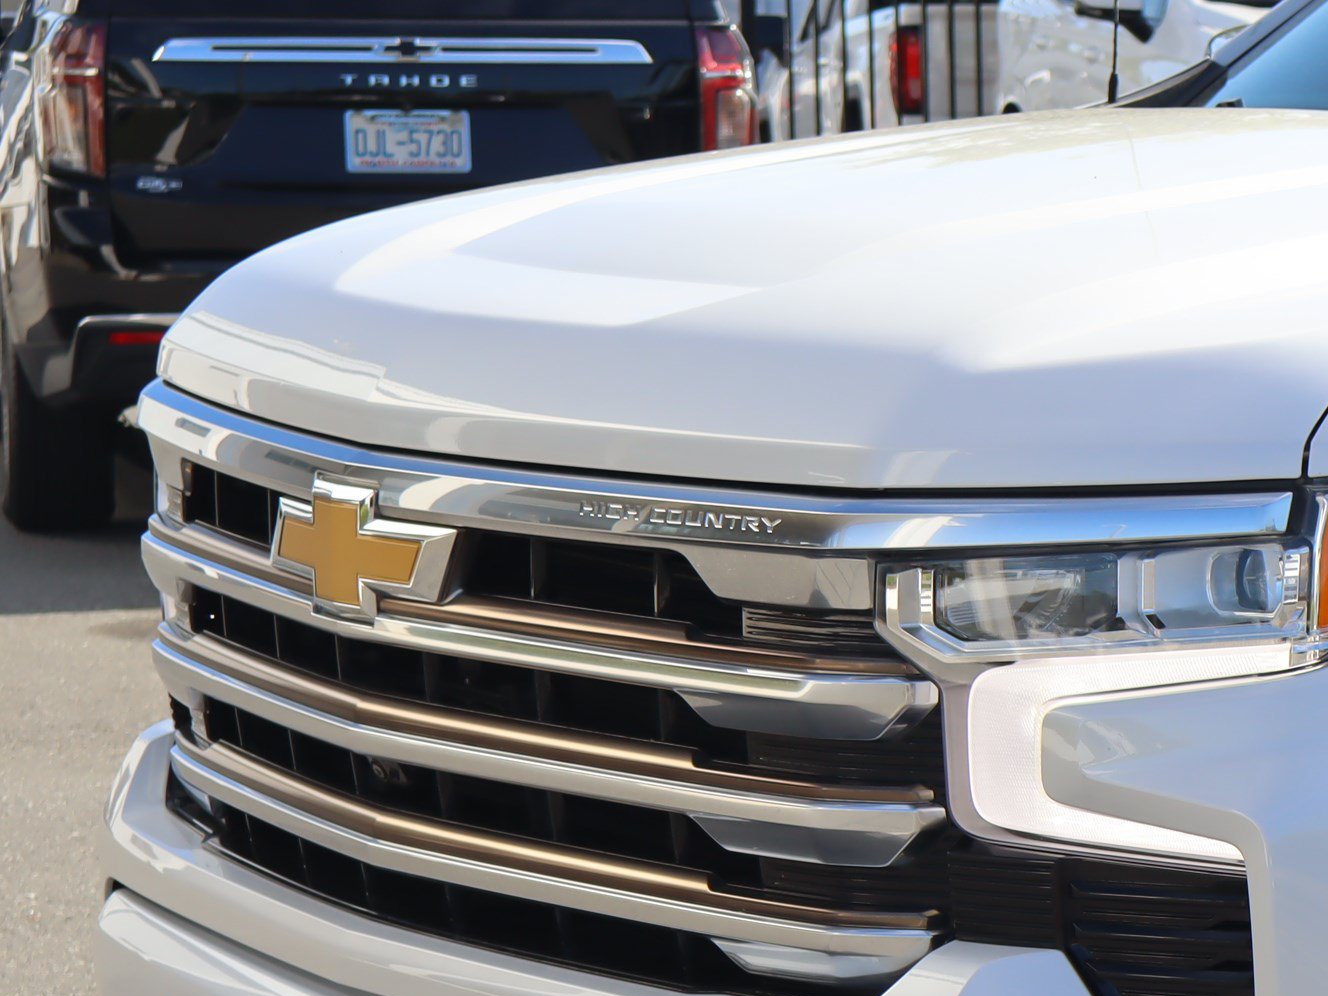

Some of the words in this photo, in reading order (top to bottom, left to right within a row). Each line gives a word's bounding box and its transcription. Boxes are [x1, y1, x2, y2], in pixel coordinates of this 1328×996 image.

[339, 73, 478, 88] TAHOE
[579, 501, 641, 521] HIGH
[649, 507, 782, 534] COUNTRY
